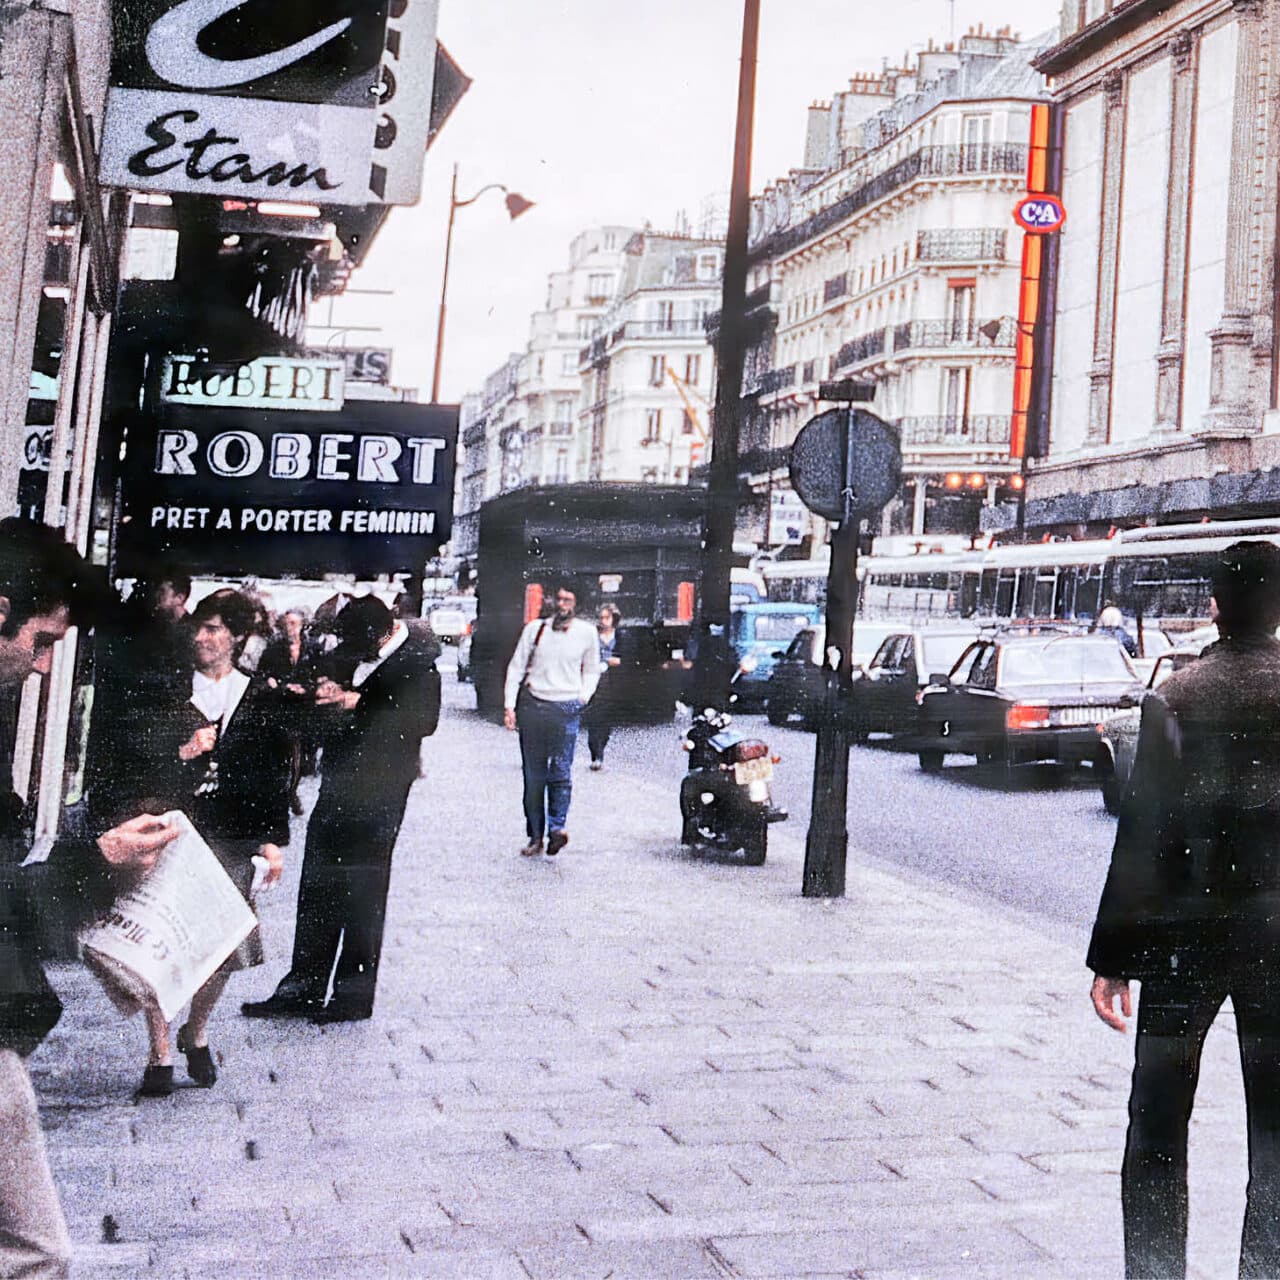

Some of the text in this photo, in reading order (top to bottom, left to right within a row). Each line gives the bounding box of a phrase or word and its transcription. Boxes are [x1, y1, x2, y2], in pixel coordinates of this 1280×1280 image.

[128, 109, 343, 190] Etam
[1020, 201, 1058, 223] C&A
[154, 429, 446, 484] ROBERT
[151, 506, 435, 534] PRET A PORTER FEMININ
